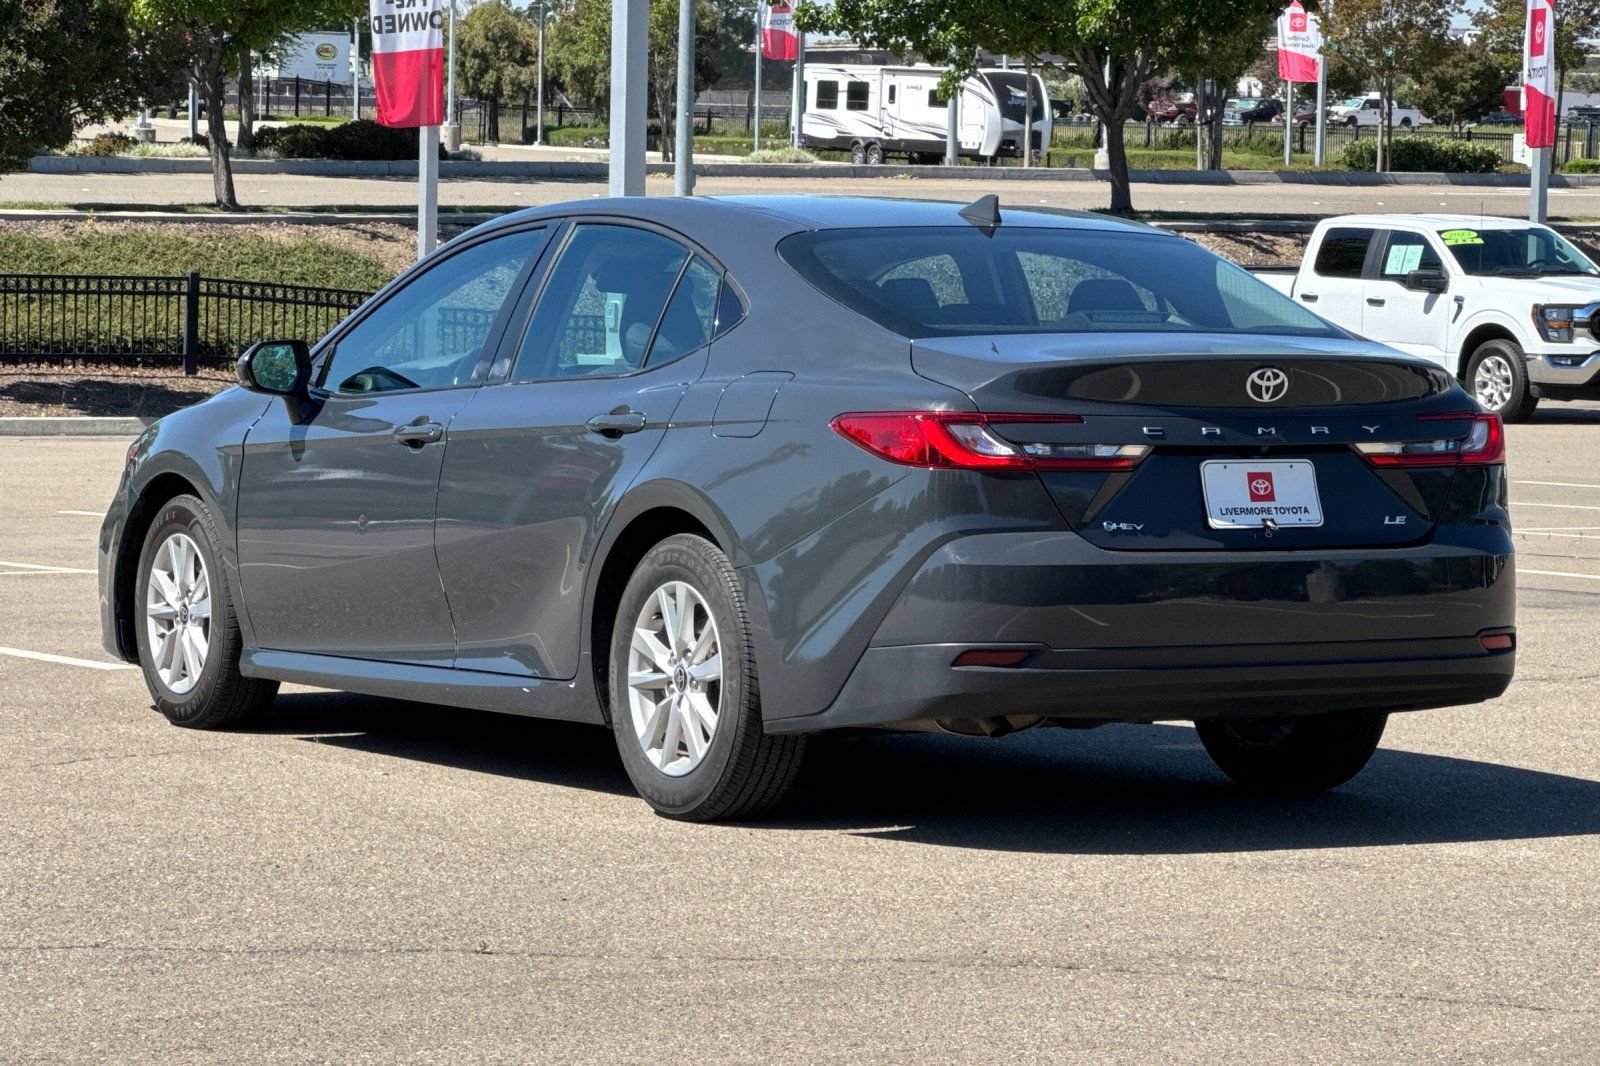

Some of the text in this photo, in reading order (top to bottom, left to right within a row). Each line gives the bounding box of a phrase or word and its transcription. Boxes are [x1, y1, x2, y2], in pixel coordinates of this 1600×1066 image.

[1142, 425, 1380, 435] CAMRY
[1220, 506, 1310, 516] LIVERMORE TOYOTA
[1384, 515, 1407, 525] LE
